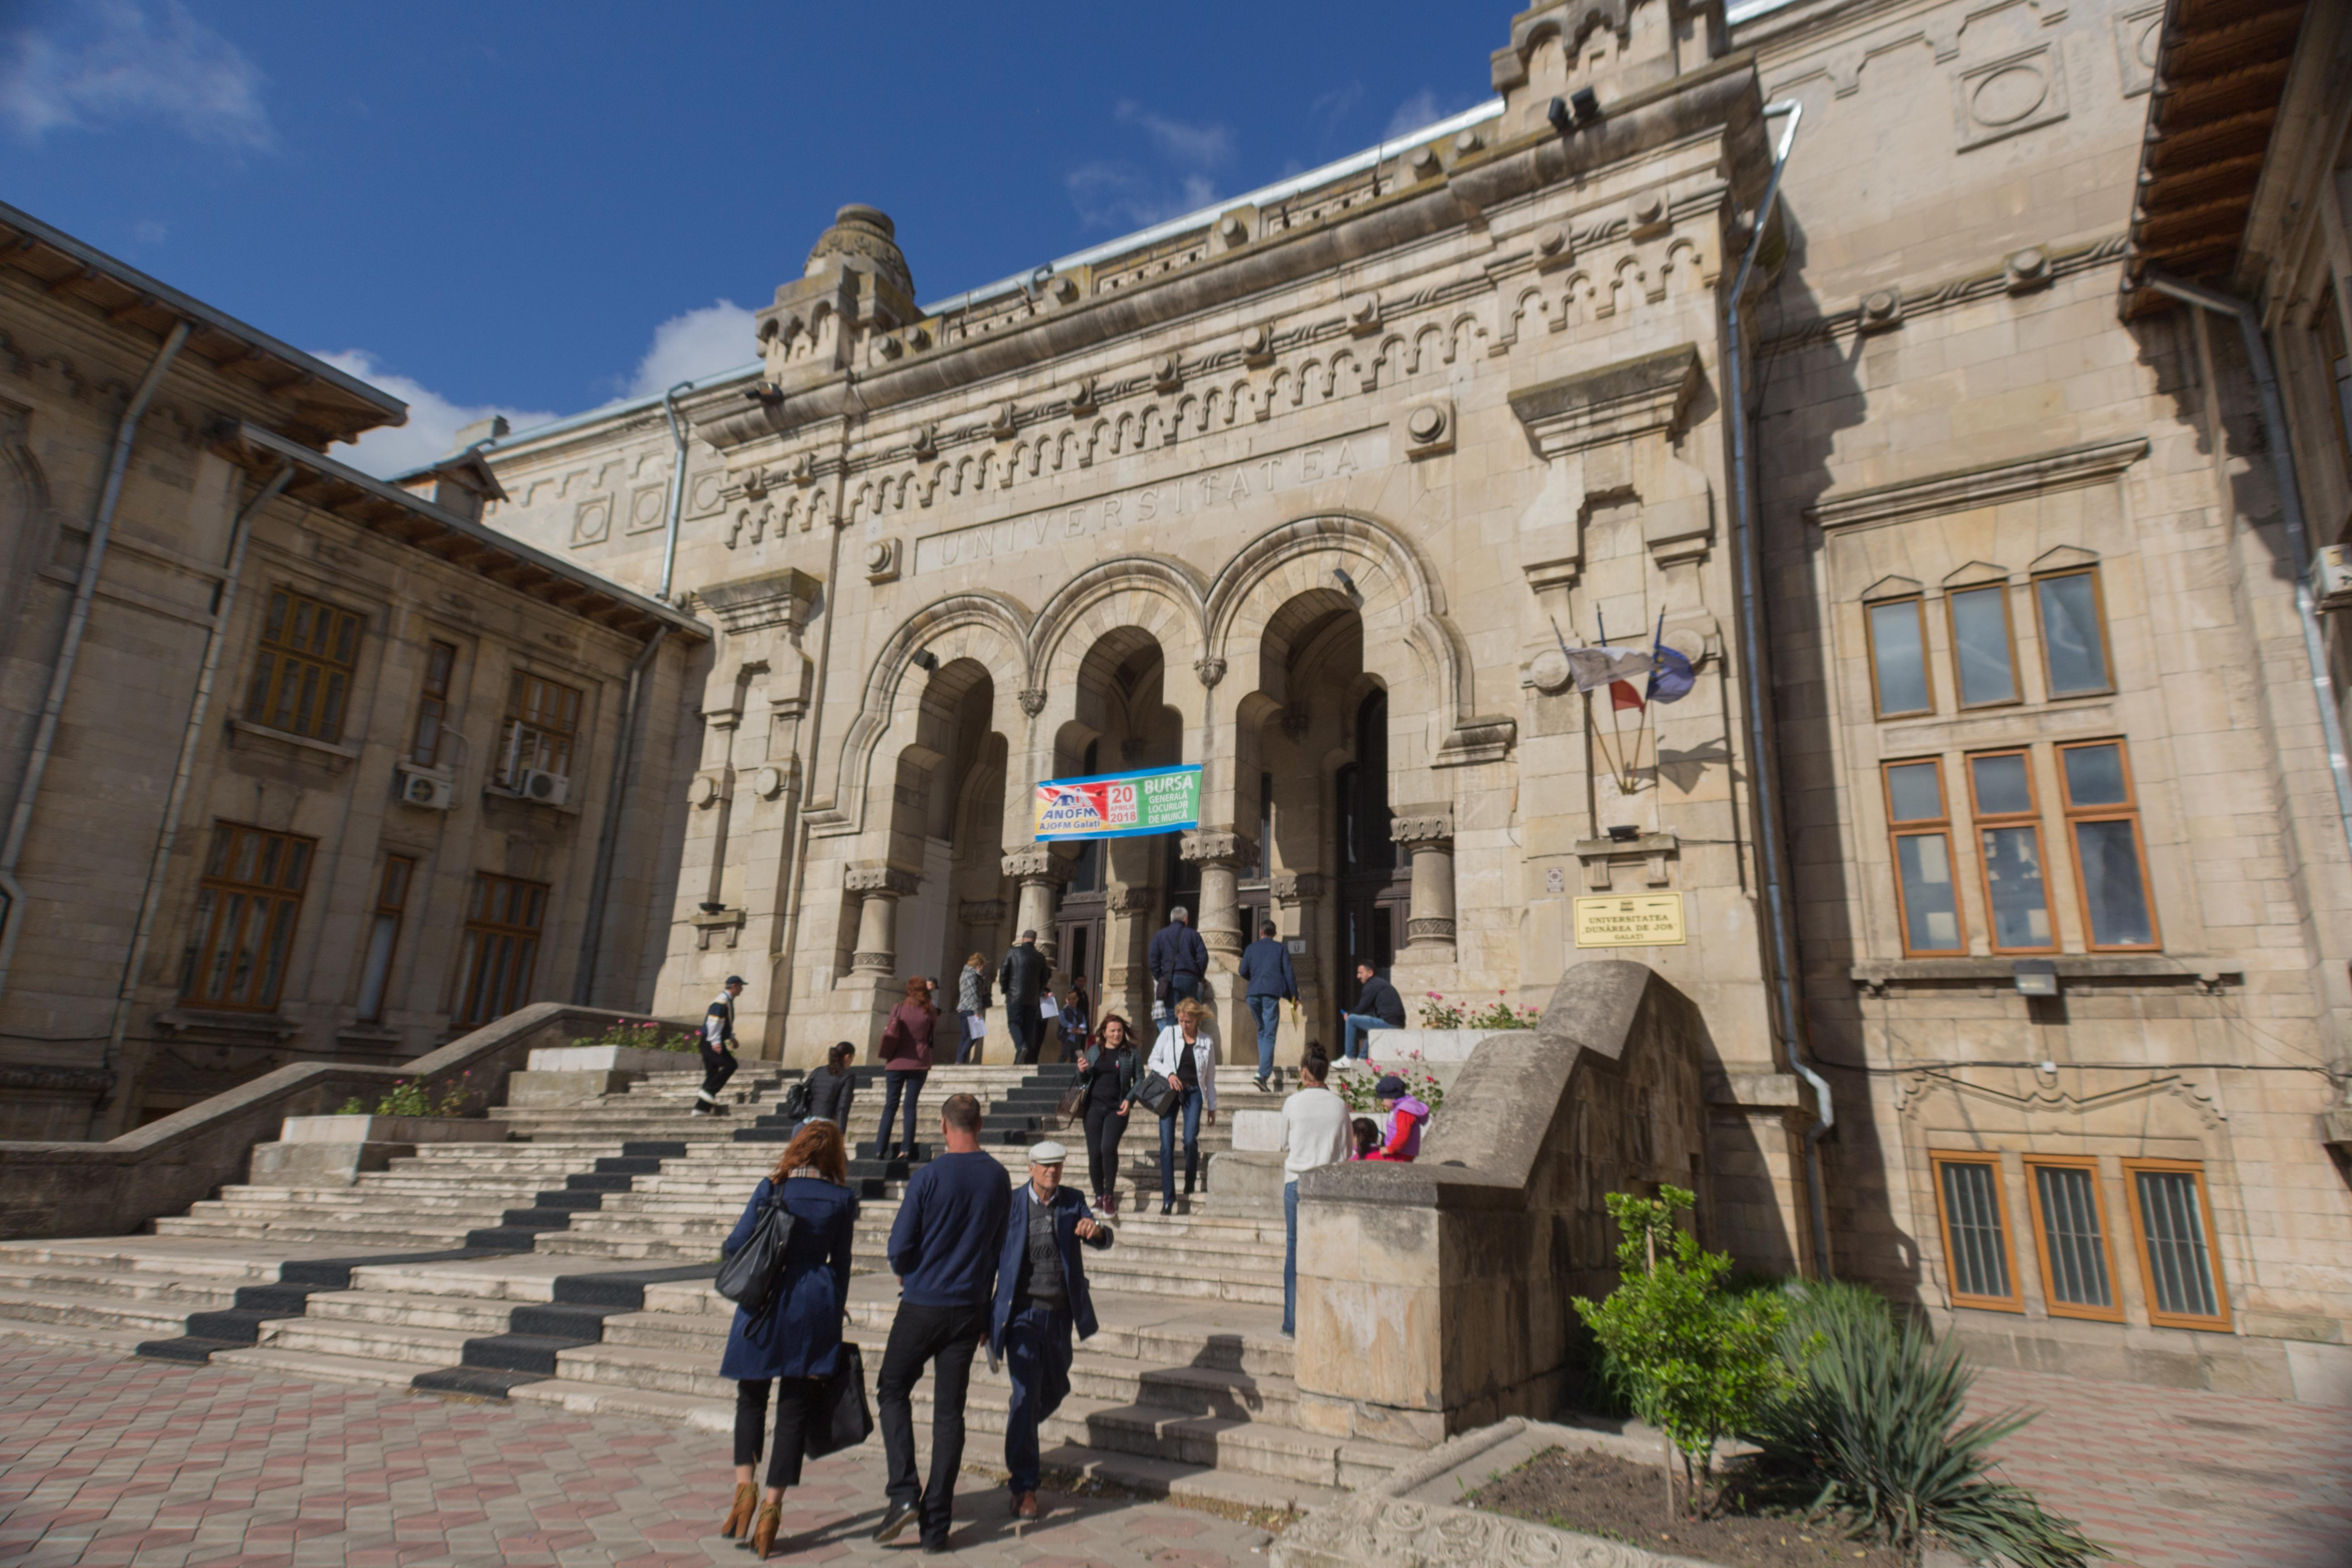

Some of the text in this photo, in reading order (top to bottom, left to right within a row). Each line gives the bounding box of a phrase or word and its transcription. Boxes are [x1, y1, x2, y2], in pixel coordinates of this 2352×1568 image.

[939, 439, 1360, 566] UNIVERSITATEA
[1144, 775, 1193, 795] BURSA
[1112, 786, 1132, 803] 20
[1149, 789, 1187, 804] GENERALĂ
[1042, 807, 1098, 819] ANOFM
[1148, 800, 1188, 813] LOCURILOR
[1110, 811, 1136, 823] 2018
[1148, 809, 1187, 824] DE MUNCĂ
[1039, 822, 1071, 830] AJOFM
[1589, 914, 1669, 924] UNIVERSITATEA
